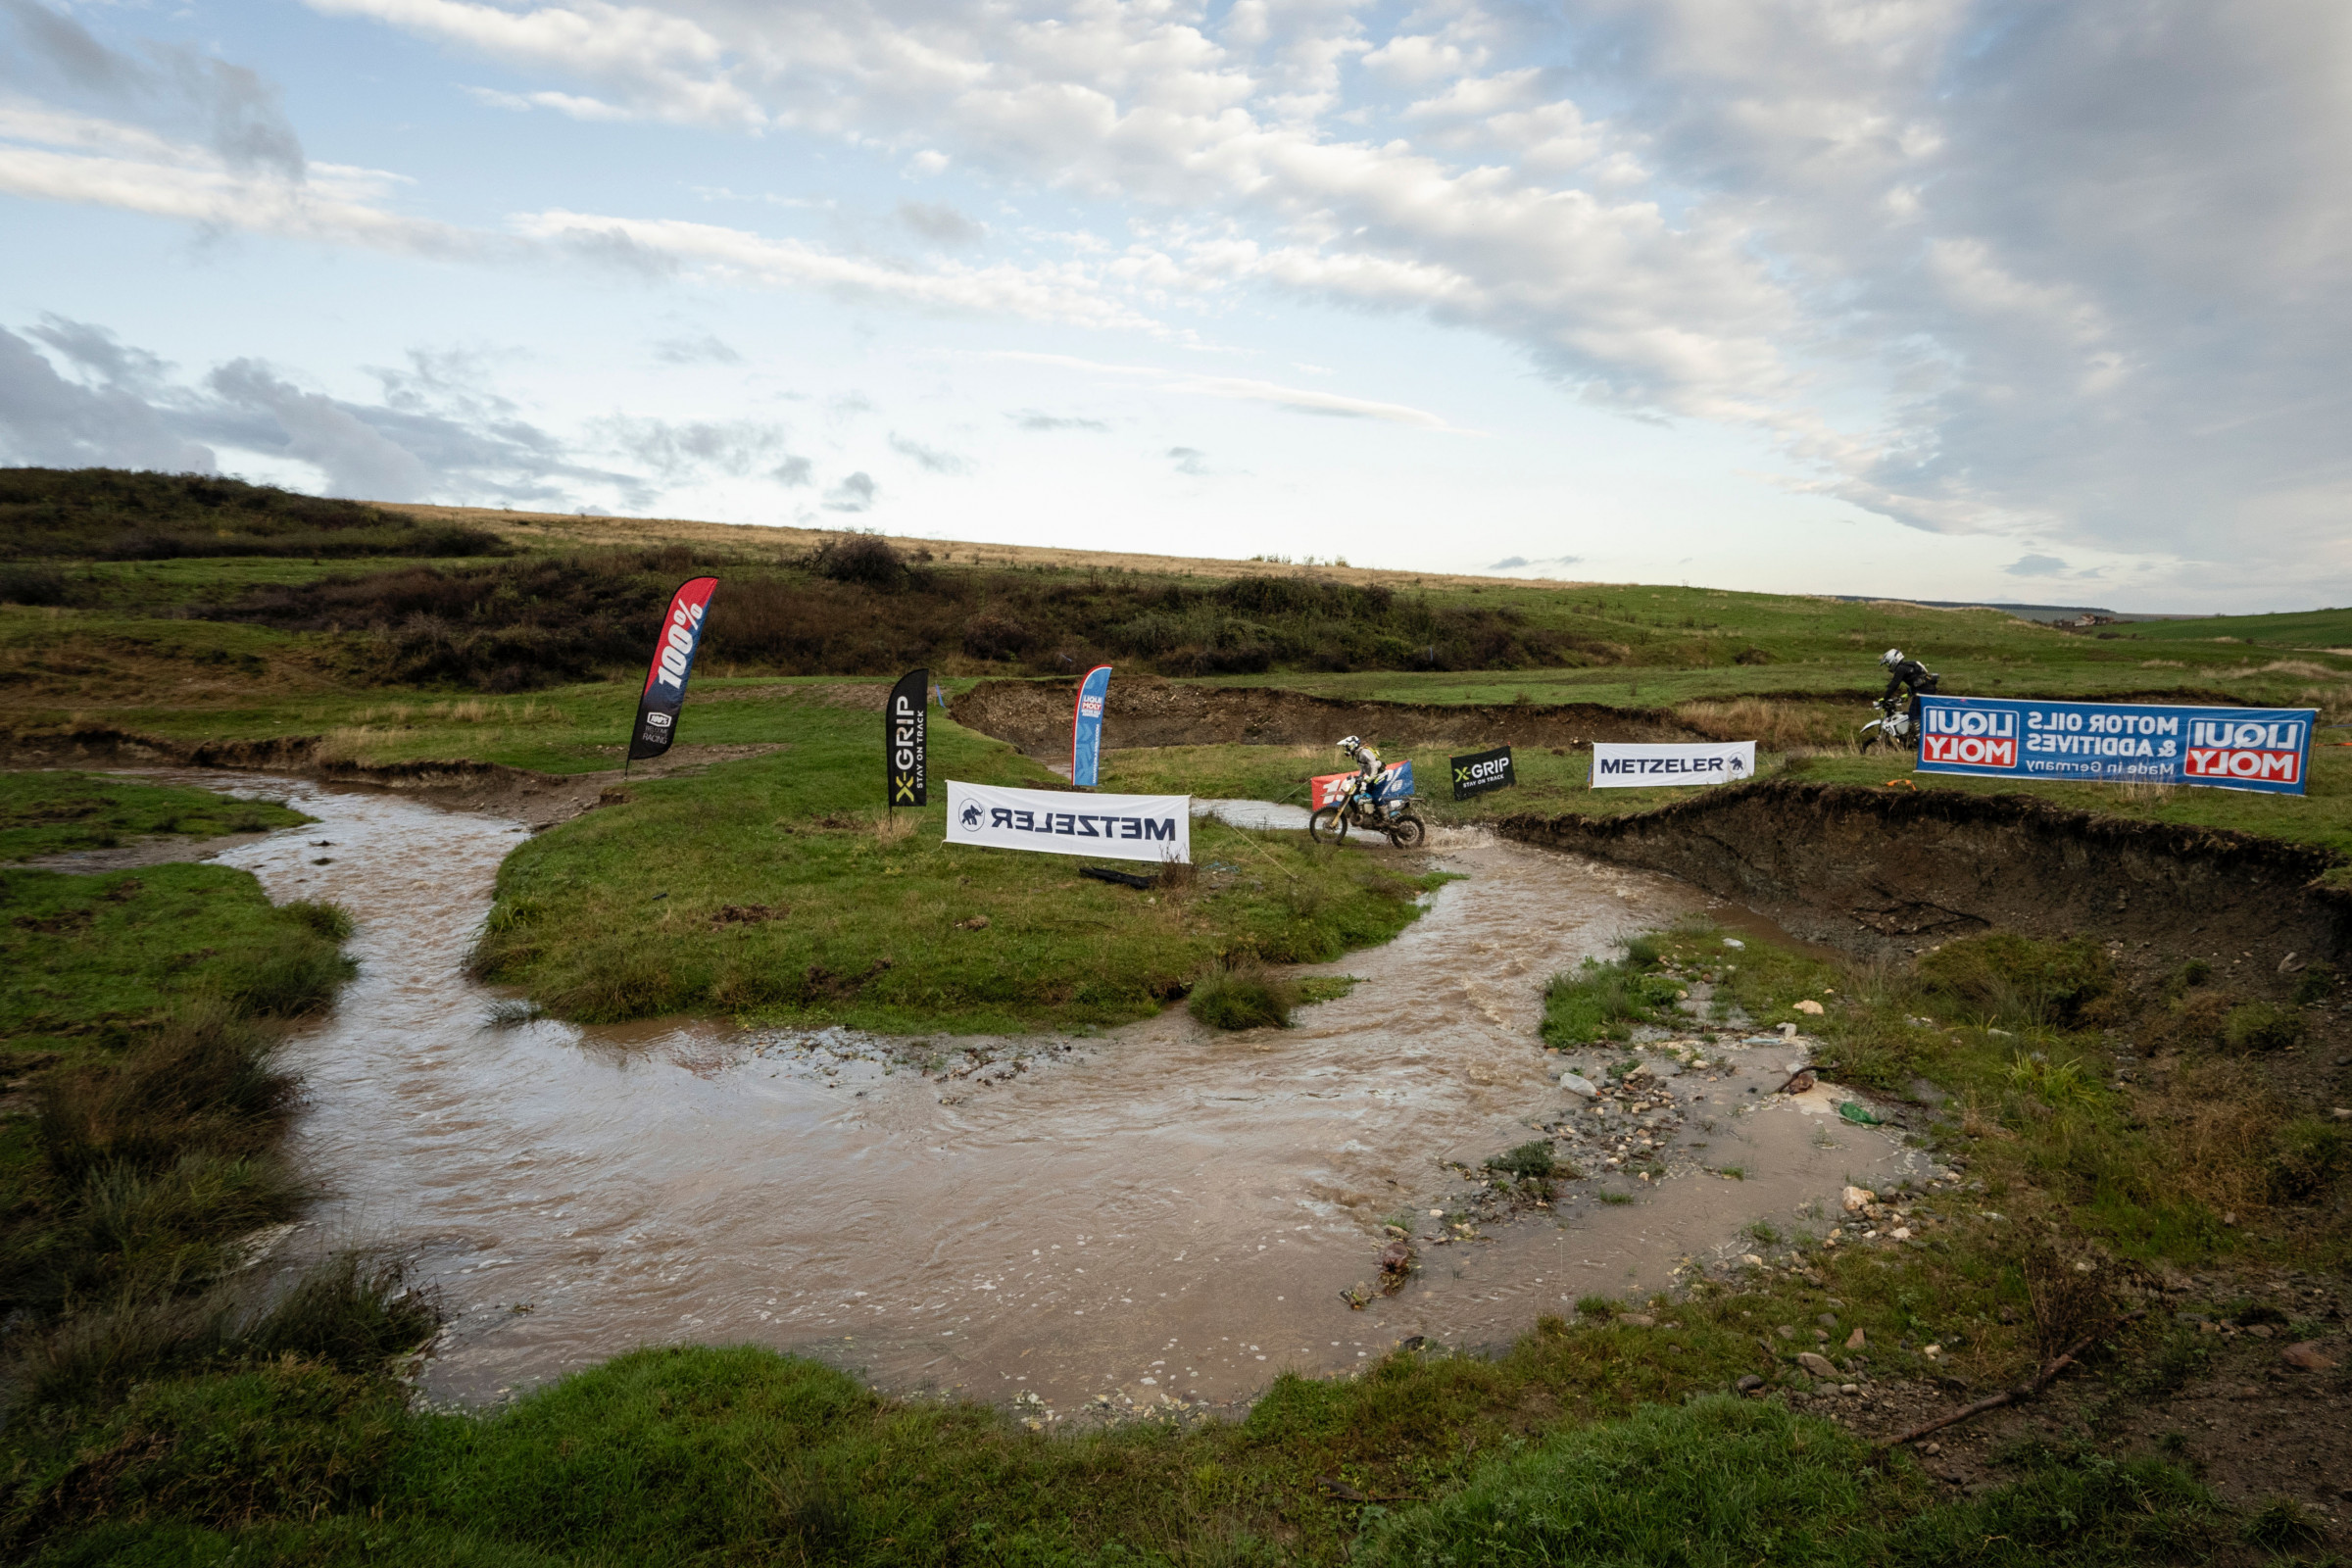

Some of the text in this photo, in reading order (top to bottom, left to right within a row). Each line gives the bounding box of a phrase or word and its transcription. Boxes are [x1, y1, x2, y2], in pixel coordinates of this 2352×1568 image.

[658, 598, 703, 689] 100%
[1082, 702, 1102, 711] MOLY
[642, 732, 667, 745] RACING
[896, 695, 915, 803] X-GRIP
[916, 746, 924, 761] ON
[1454, 757, 1510, 783] X-GRIP
[1600, 758, 1724, 774] METZELER
[1487, 773, 1504, 782] TRACK
